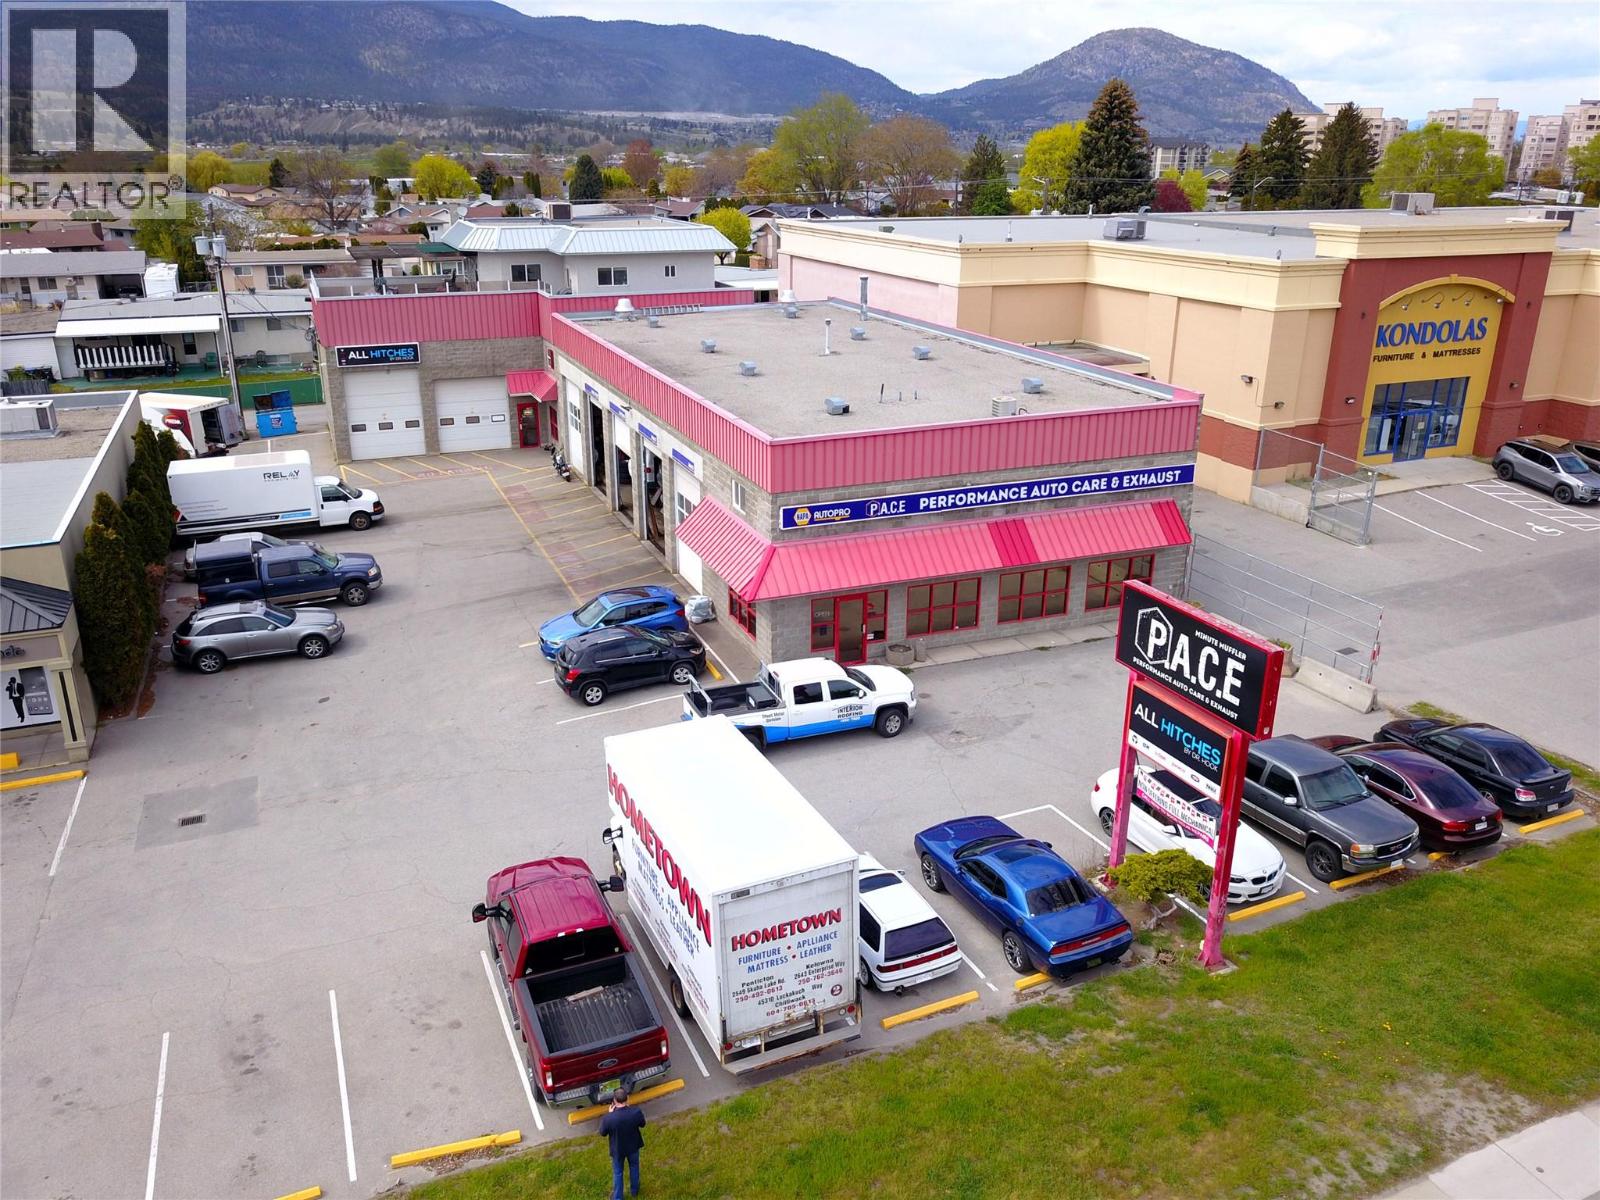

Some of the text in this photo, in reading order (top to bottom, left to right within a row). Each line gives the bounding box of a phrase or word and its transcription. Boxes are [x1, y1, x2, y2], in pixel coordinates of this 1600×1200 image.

[1376, 317, 1488, 348] KONDOLAS
[348, 348, 414, 360] ALL HITCHES
[1373, 352, 1415, 362] FURNITURE
[1433, 348, 1481, 358] MATTRESSES
[263, 469, 300, 479] RELAY
[919, 486, 1028, 510] PERFORMANCE
[1033, 482, 1068, 497] AUTO
[1072, 478, 1107, 493] CARE
[1111, 477, 1119, 488] &
[1123, 470, 1181, 487] EXHAUST
[796, 511, 809, 520] NAPA
[814, 508, 850, 519] AUTOPRO
[1195, 630, 1247, 661] MINUTE MUFFLER
[1132, 656, 1238, 720] PERFORMANCE AUTO CARE & EXHAUST
[837, 704, 864, 713] INTERIOR
[837, 711, 864, 719] ROOFING
[1134, 703, 1221, 766] ALL HITCHES
[1183, 746, 1191, 756] BY
[1202, 757, 1219, 772] HOCK
[608, 763, 712, 948] HOMETOWN
[731, 908, 842, 952] HOMETOWN
[738, 947, 782, 966] FURNITURE
[747, 943, 832, 974] MATTRESS LEATHER
[805, 958, 834, 970] Kelowna
[741, 975, 774, 988] Penticton
[764, 980, 777, 988] Lake
[774, 995, 805, 1007] Chilliwack
